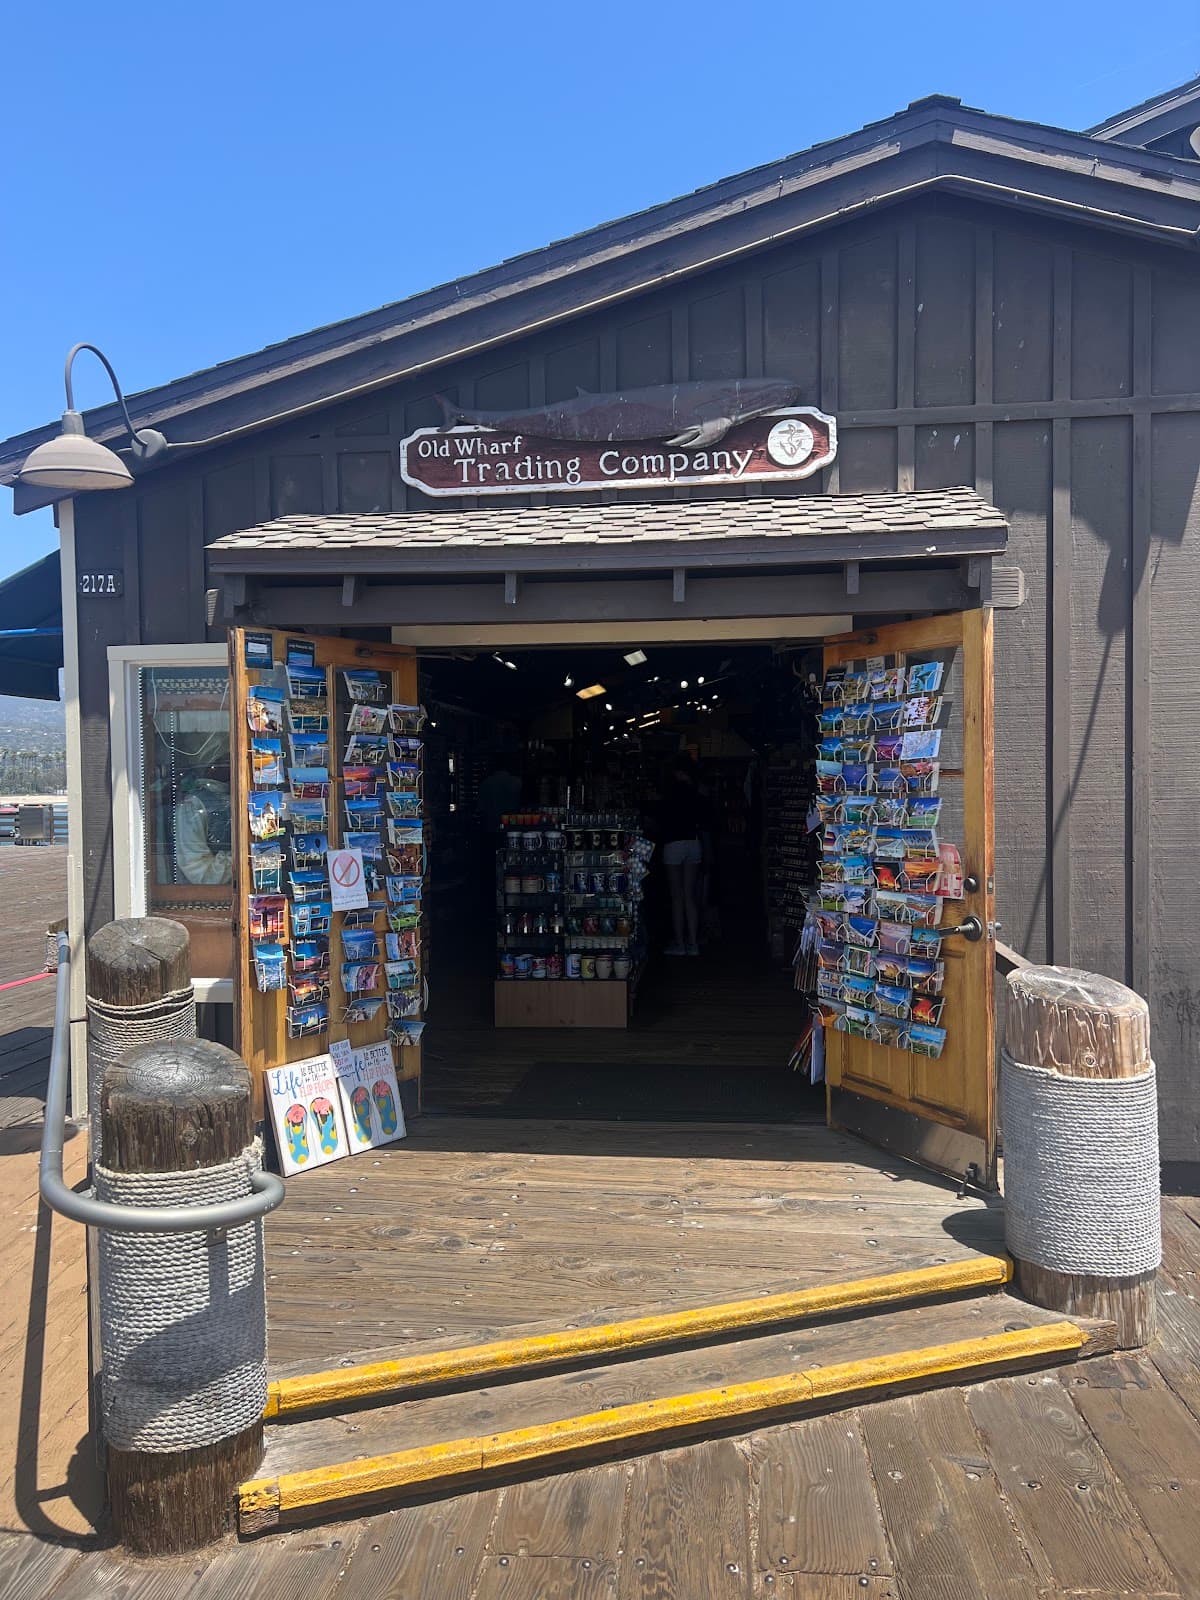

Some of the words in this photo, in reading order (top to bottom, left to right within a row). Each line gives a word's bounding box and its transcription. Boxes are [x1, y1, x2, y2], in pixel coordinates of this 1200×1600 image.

[418, 439, 450, 458] Old
[454, 435, 523, 456] Wharf
[453, 455, 581, 485] Trading
[599, 449, 753, 482] Company
[82, 574, 116, 593] 217A
[271, 1069, 303, 1099] Life
